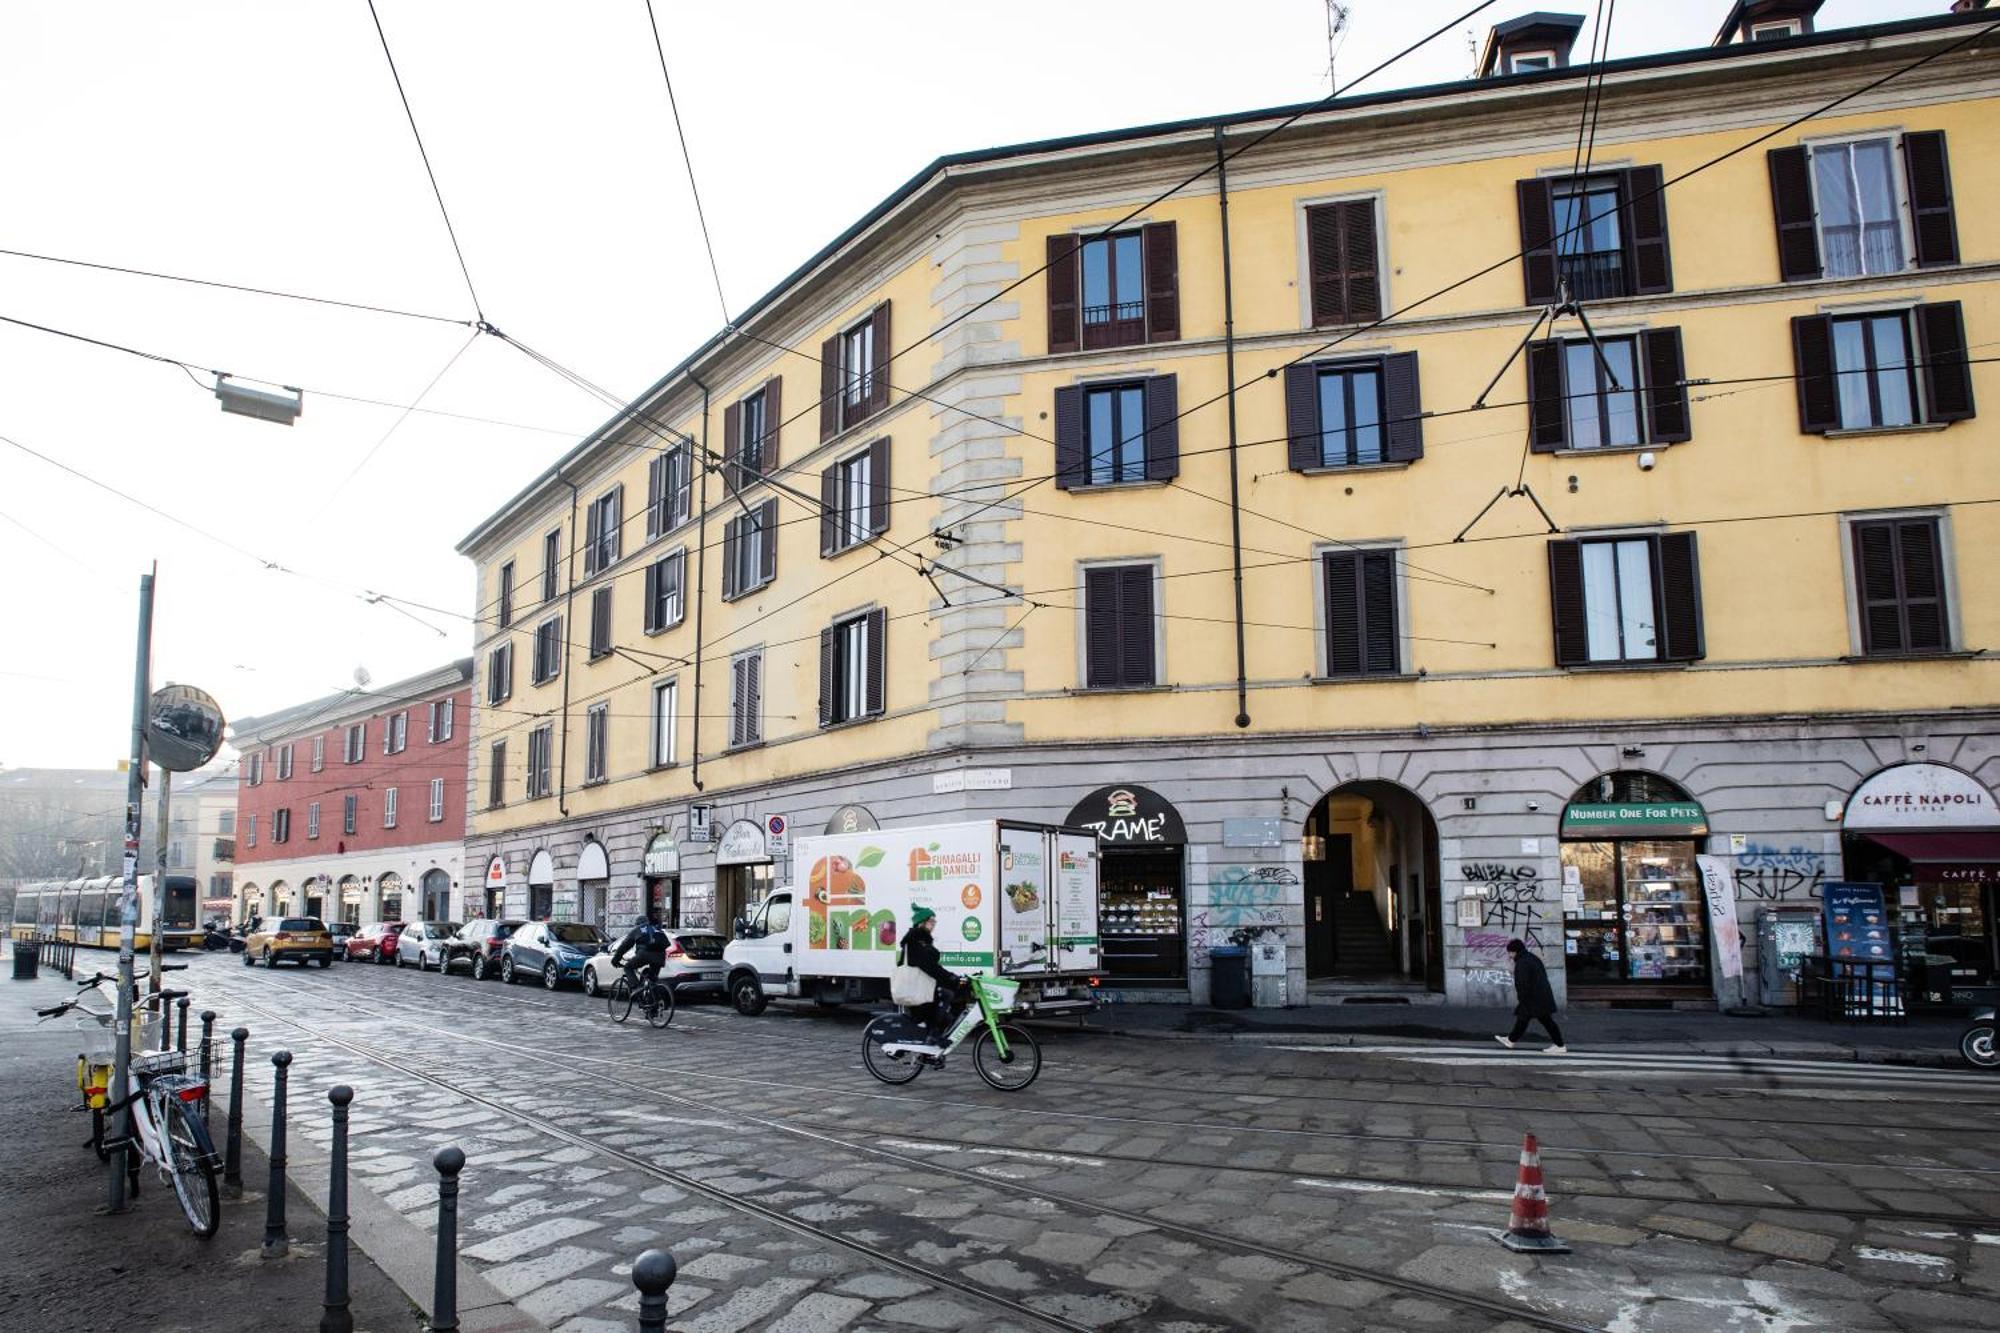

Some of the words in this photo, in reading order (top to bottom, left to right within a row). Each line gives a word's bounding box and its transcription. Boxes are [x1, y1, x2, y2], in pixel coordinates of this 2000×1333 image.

[1863, 792, 1912, 806] CAFFÈ
[1920, 794, 1981, 805] NAPOLI
[931, 853, 981, 864] FUMAGALLI
[943, 864, 976, 876] DANILO
